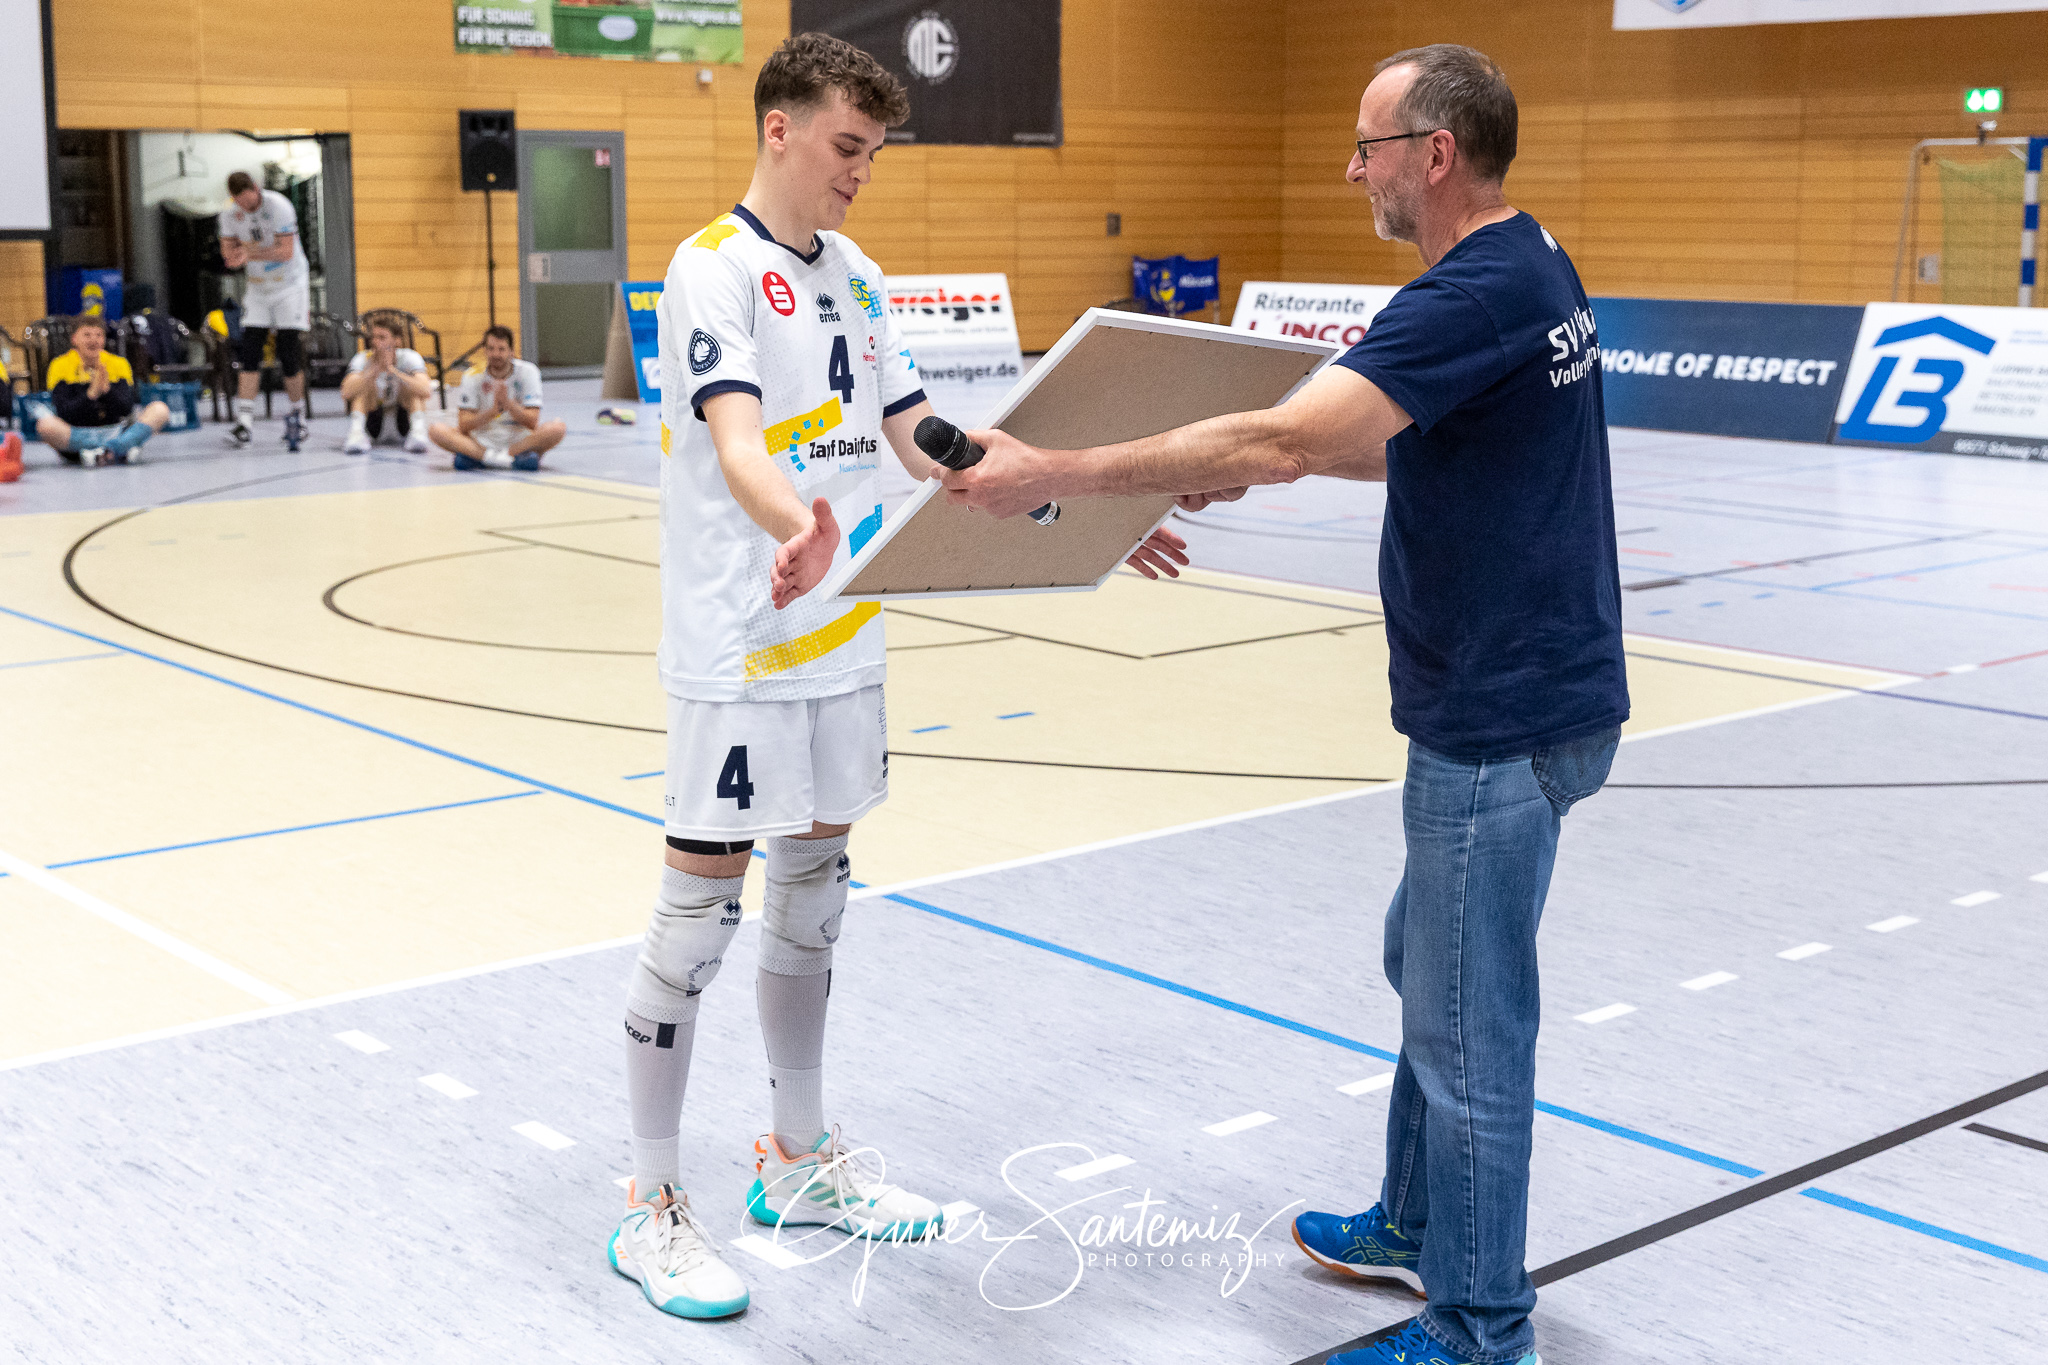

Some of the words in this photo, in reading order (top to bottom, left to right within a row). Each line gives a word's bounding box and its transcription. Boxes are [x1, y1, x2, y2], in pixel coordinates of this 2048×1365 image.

[1254, 292, 1365, 315] Ristorante
[828, 335, 854, 404] 4
[1601, 348, 1673, 377] HOME
[1674, 352, 1714, 379] OF
[1712, 354, 1838, 387] RESPECT
[716, 745, 754, 810] 4
